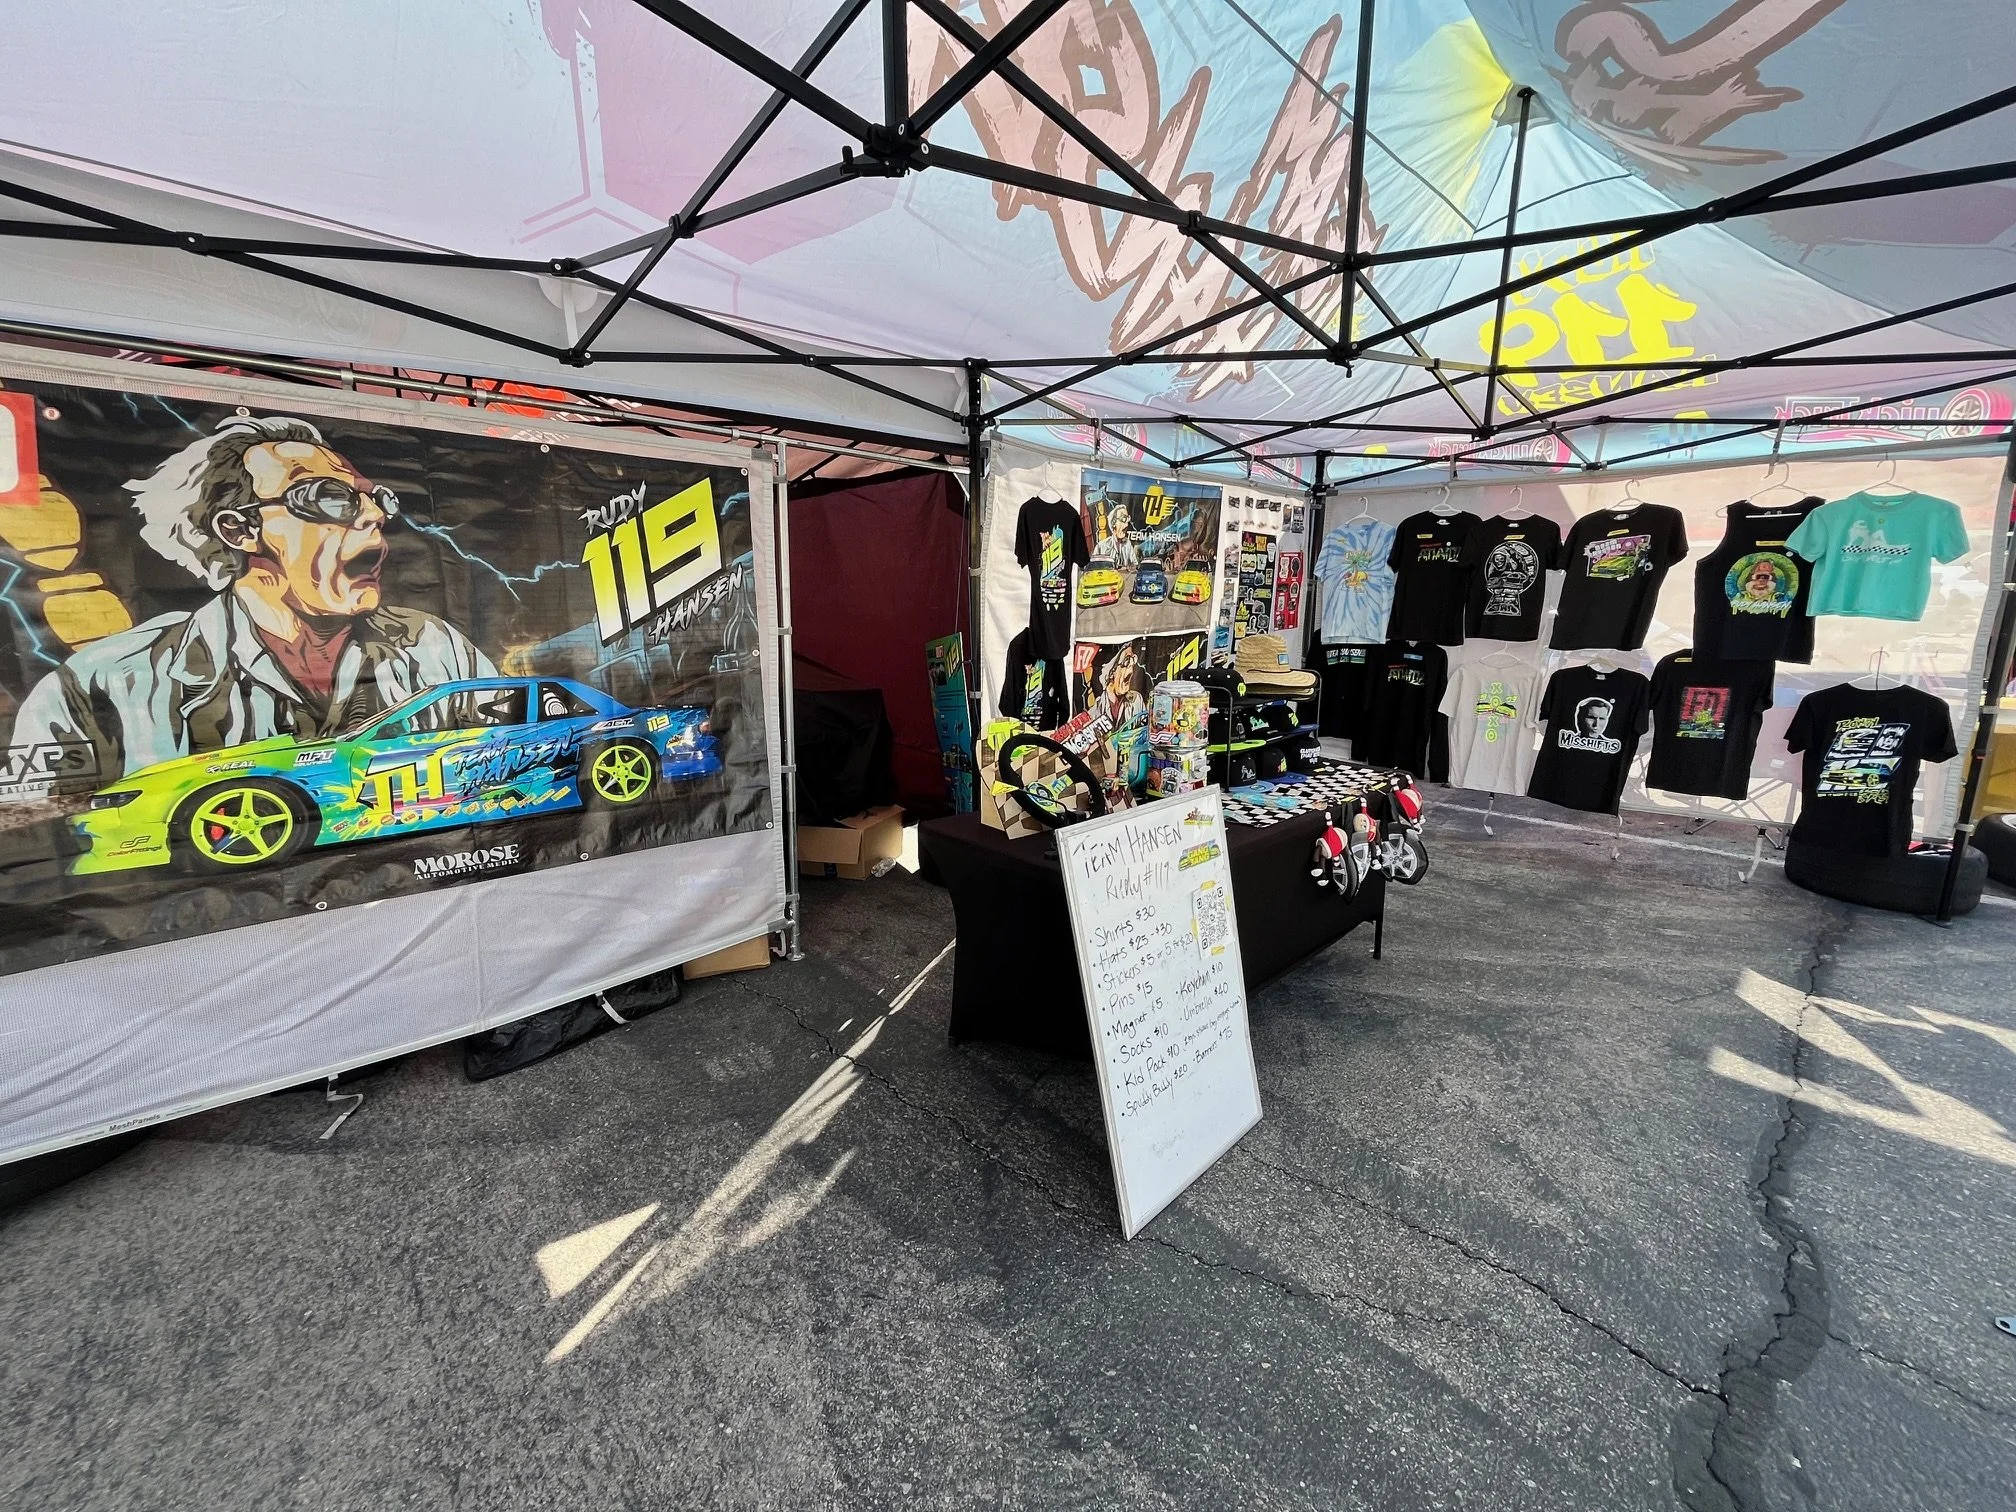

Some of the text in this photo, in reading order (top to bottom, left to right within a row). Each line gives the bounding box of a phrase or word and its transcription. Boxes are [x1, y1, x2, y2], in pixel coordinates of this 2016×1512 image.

[578, 480, 647, 536] RUDY
[1126, 530, 1181, 542] TEAM HANSEN
[581, 476, 723, 642] 119
[649, 563, 743, 646] HANSEN
[647, 713, 671, 733] 119
[0, 781, 56, 796] EATIVES
[413, 844, 521, 876] MOROSE
[1125, 821, 1183, 863] HANSEN
[416, 858, 520, 881] AUTOMOTIVE MEDIA
[1094, 905, 1156, 948] Shirts $30
[1100, 946, 1128, 971] Hats
[1129, 934, 1149, 950] $25
[1109, 981, 1154, 1015] Pins $15
[1111, 1012, 1148, 1040] Magnet
[1119, 1036, 1153, 1064] Socks
[1154, 1022, 1169, 1039] $10
[1123, 1066, 1145, 1096] Kid
[1146, 1056, 1167, 1081] Pack
